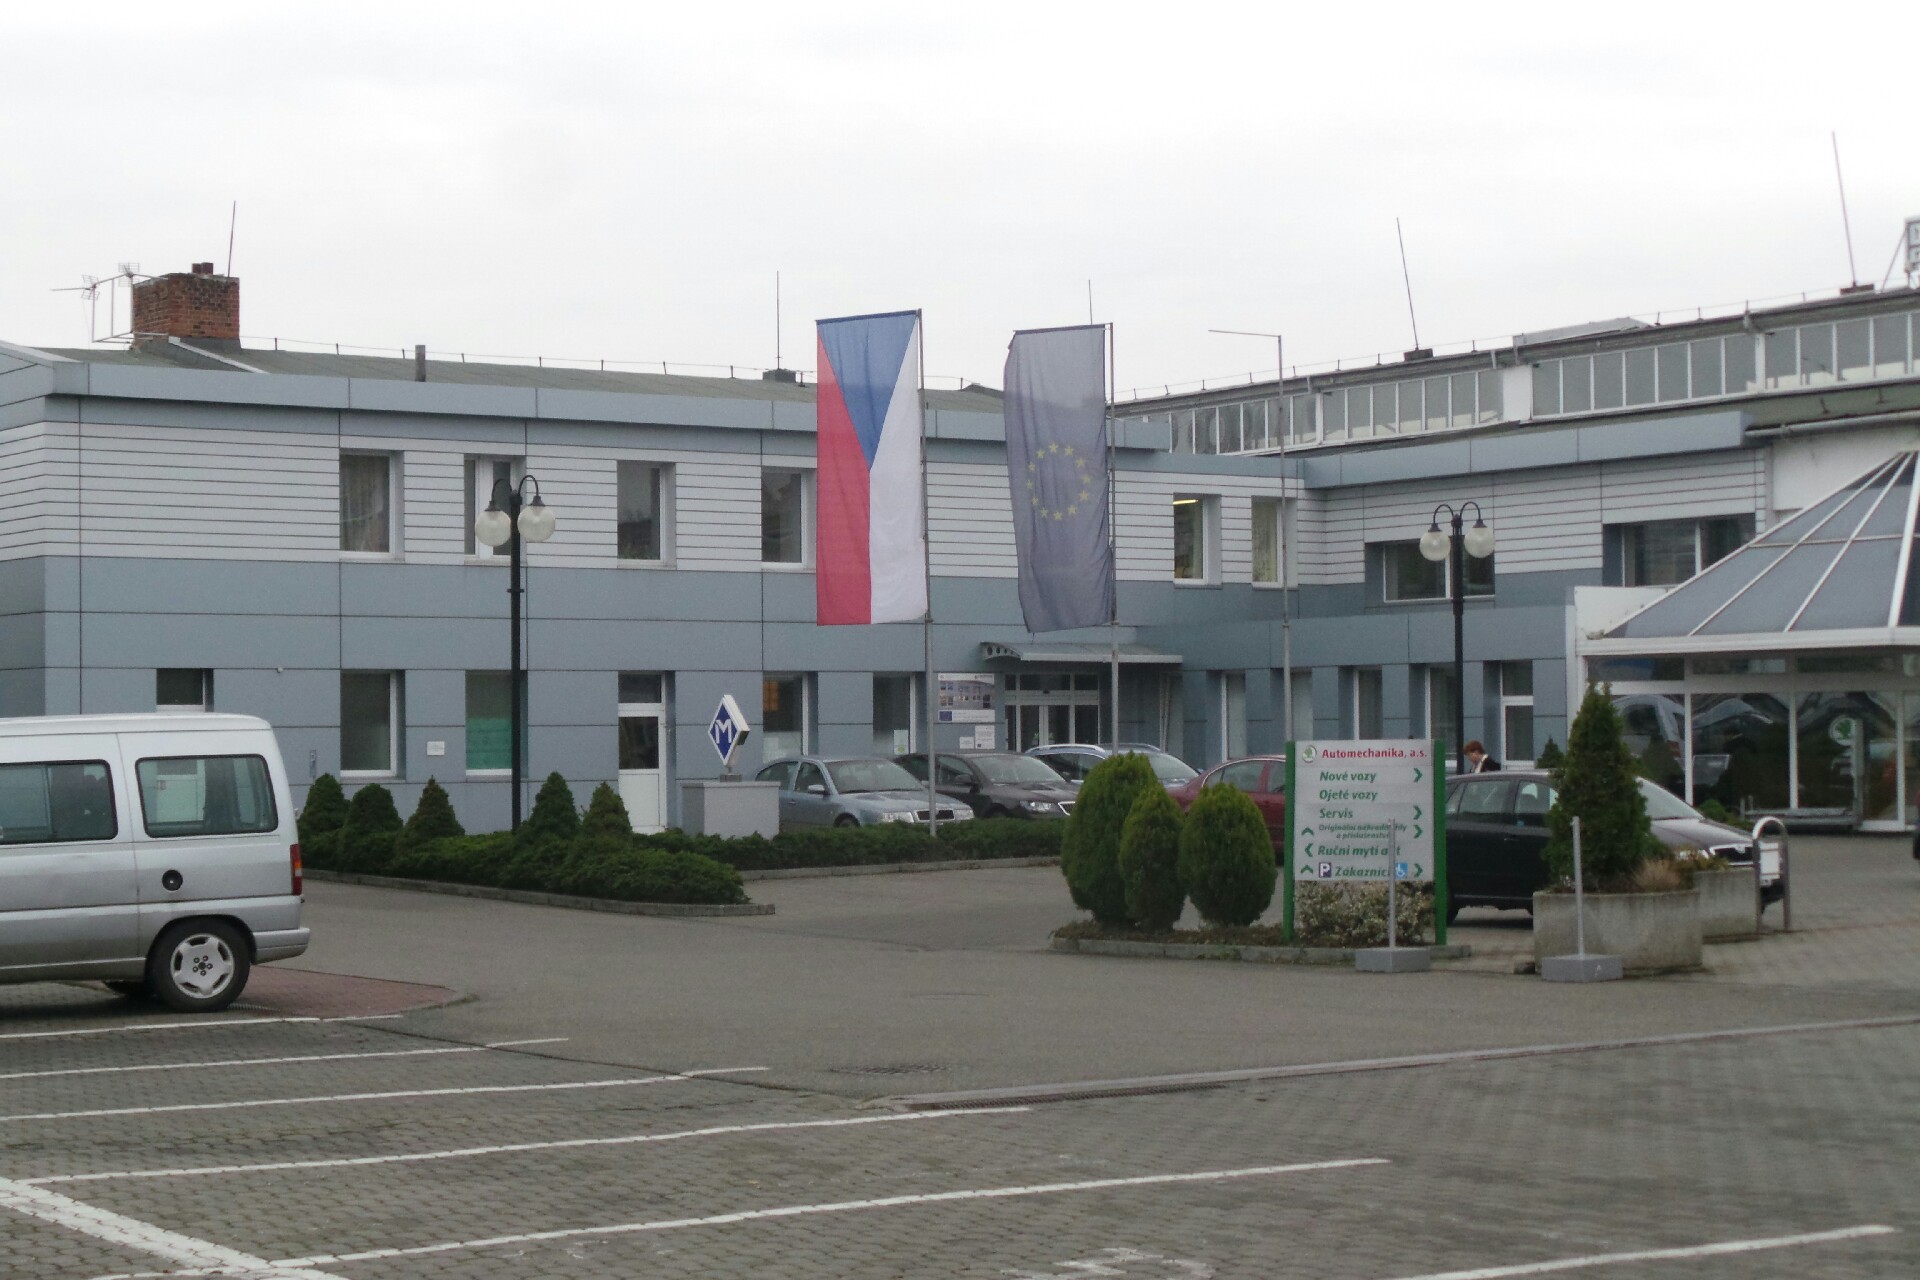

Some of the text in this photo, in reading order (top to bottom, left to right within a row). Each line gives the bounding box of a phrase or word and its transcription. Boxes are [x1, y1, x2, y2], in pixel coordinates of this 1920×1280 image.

[1321, 748, 1428, 759] Automechanika, a.s.
[1319, 770, 1377, 783] Nové vozy
[1319, 788, 1378, 802] Ojeté vozy
[1319, 807, 1354, 819] Servis
[1317, 844, 1350, 856] Ruční
[1380, 846, 1401, 856] at
